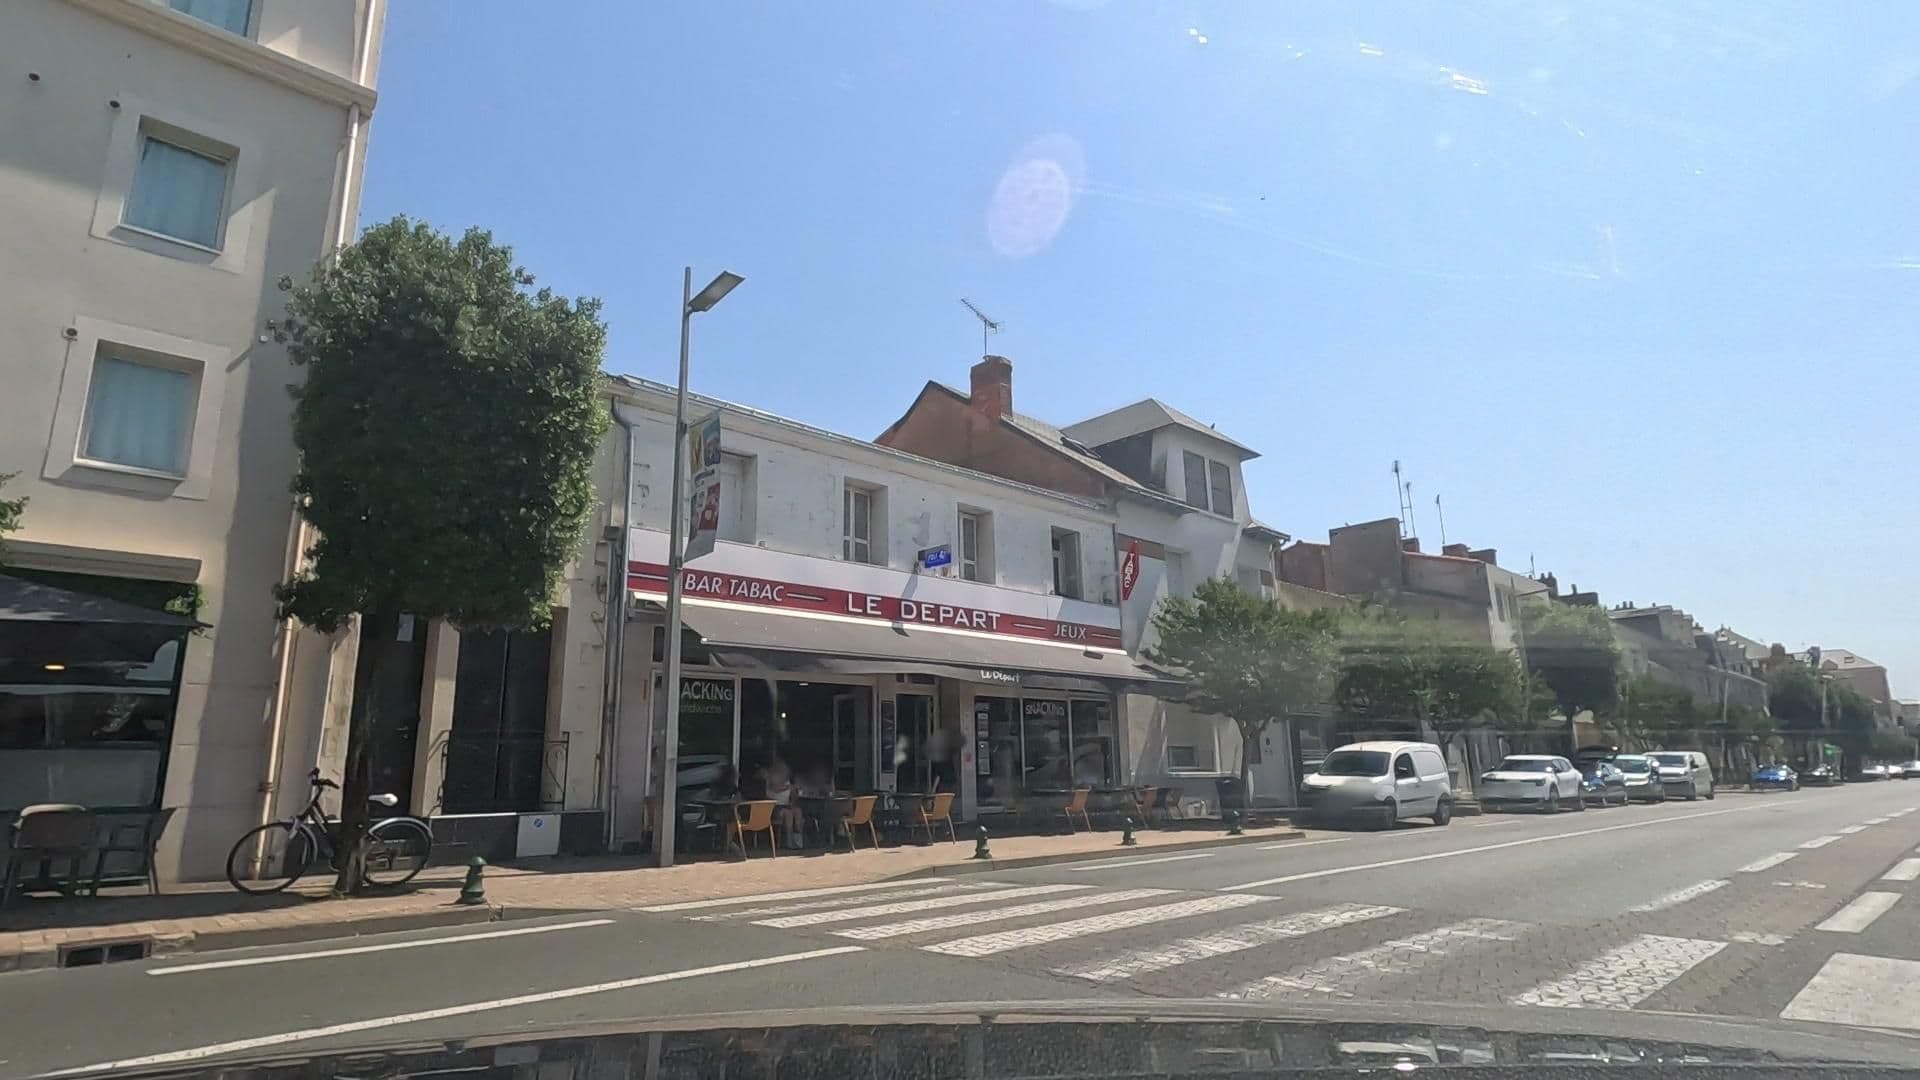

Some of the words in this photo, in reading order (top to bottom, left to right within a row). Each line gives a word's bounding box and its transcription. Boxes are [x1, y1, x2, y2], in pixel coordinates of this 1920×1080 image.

[1124, 552, 1135, 589] TABAC
[685, 573, 723, 594] BAR
[729, 579, 785, 602] TABAC
[848, 593, 883, 615] LE
[900, 600, 1001, 630] DEPART
[1053, 623, 1088, 640] JEUX
[680, 681, 734, 701] ACKING
